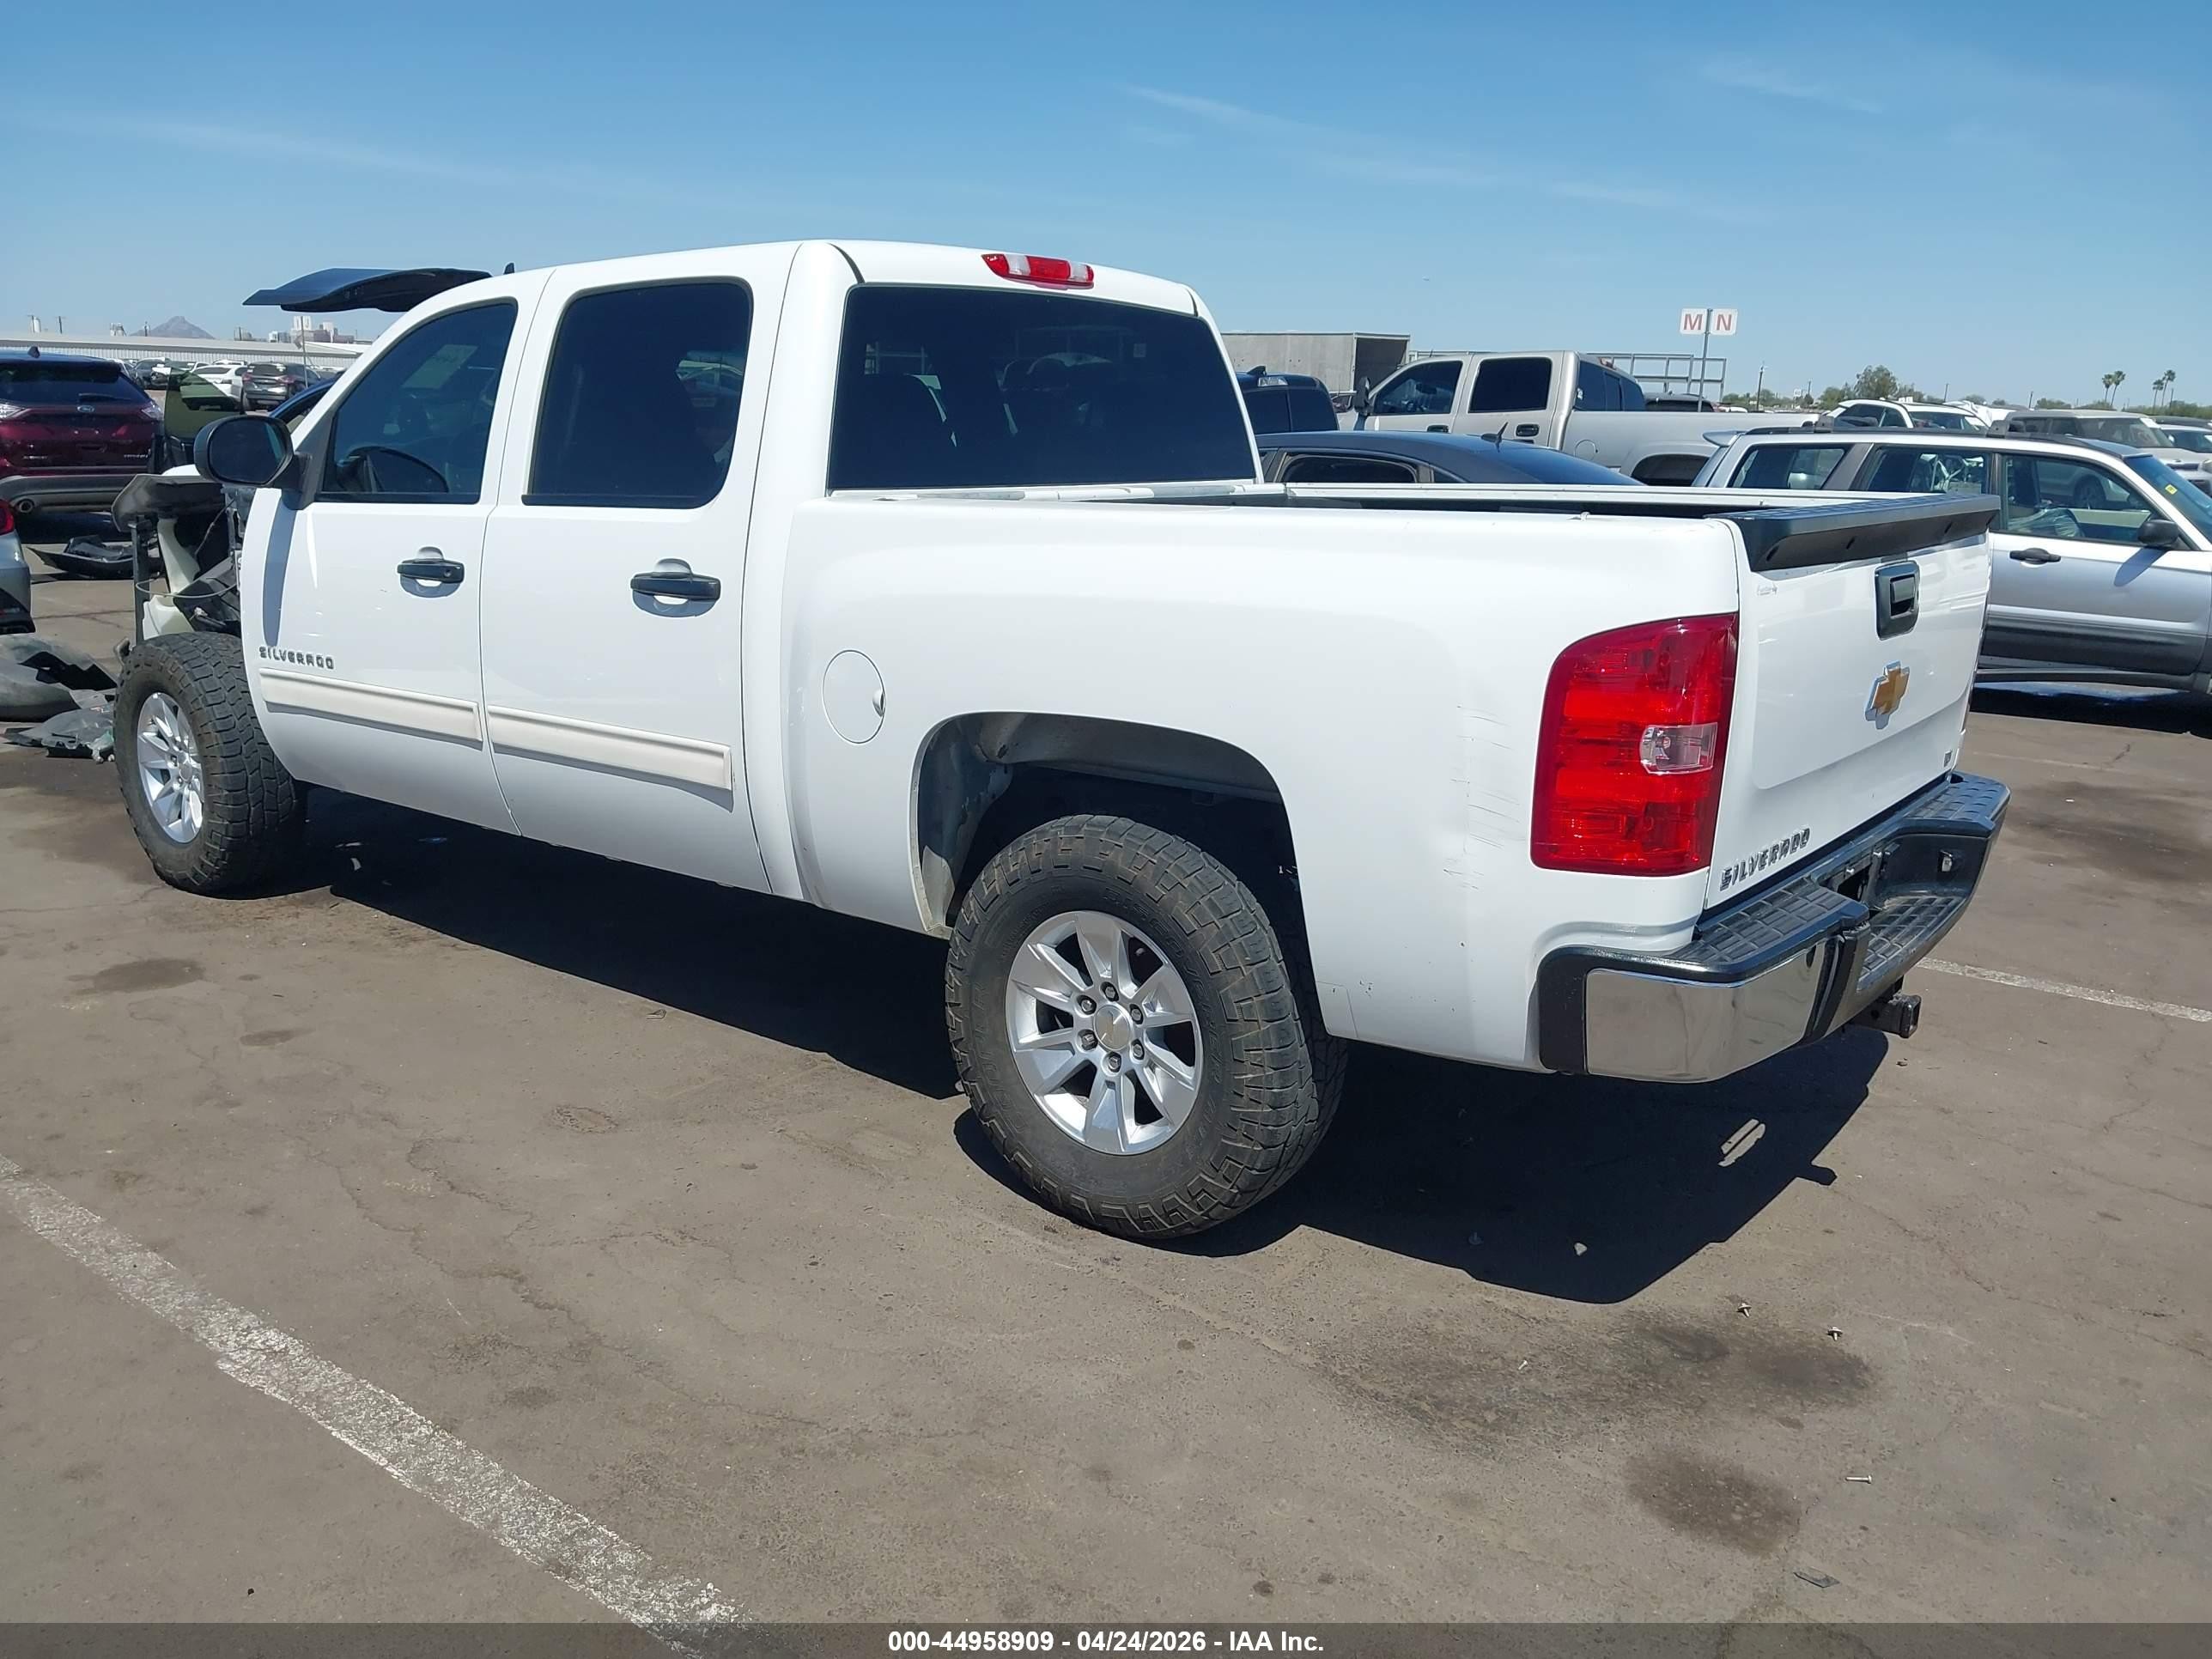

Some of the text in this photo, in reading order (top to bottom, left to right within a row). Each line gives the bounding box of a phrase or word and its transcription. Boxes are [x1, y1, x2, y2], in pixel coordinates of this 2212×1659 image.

[1683, 313, 1704, 331] M
[1716, 313, 1733, 331] N
[258, 646, 334, 670] SILVERADO
[1719, 828, 1810, 892] SILVERADO
